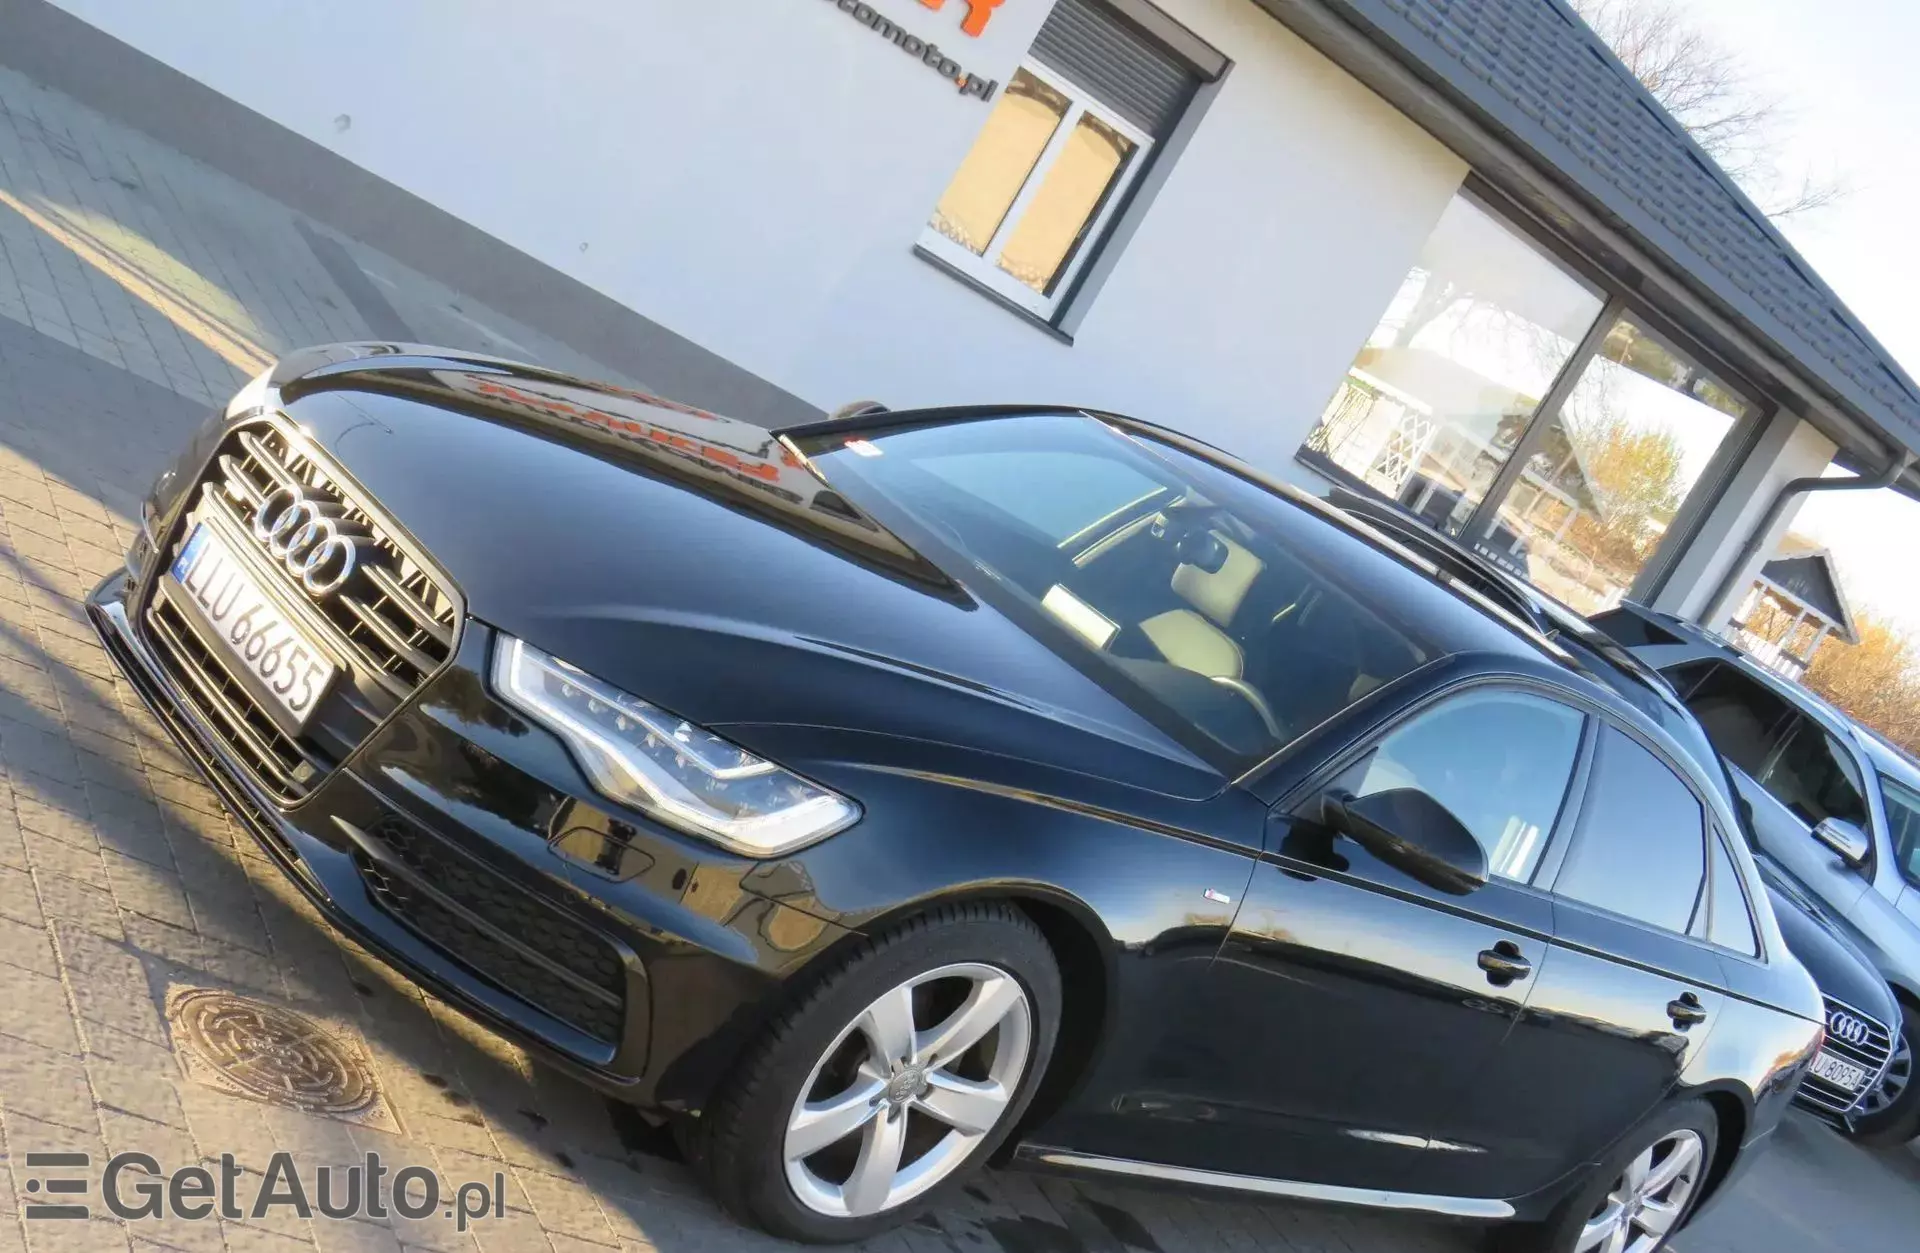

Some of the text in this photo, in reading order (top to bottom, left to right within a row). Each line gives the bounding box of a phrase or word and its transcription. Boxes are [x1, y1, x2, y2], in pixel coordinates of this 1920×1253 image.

[823, 0, 999, 102] tomoto.pl
[185, 541, 325, 711] LLU 66655
